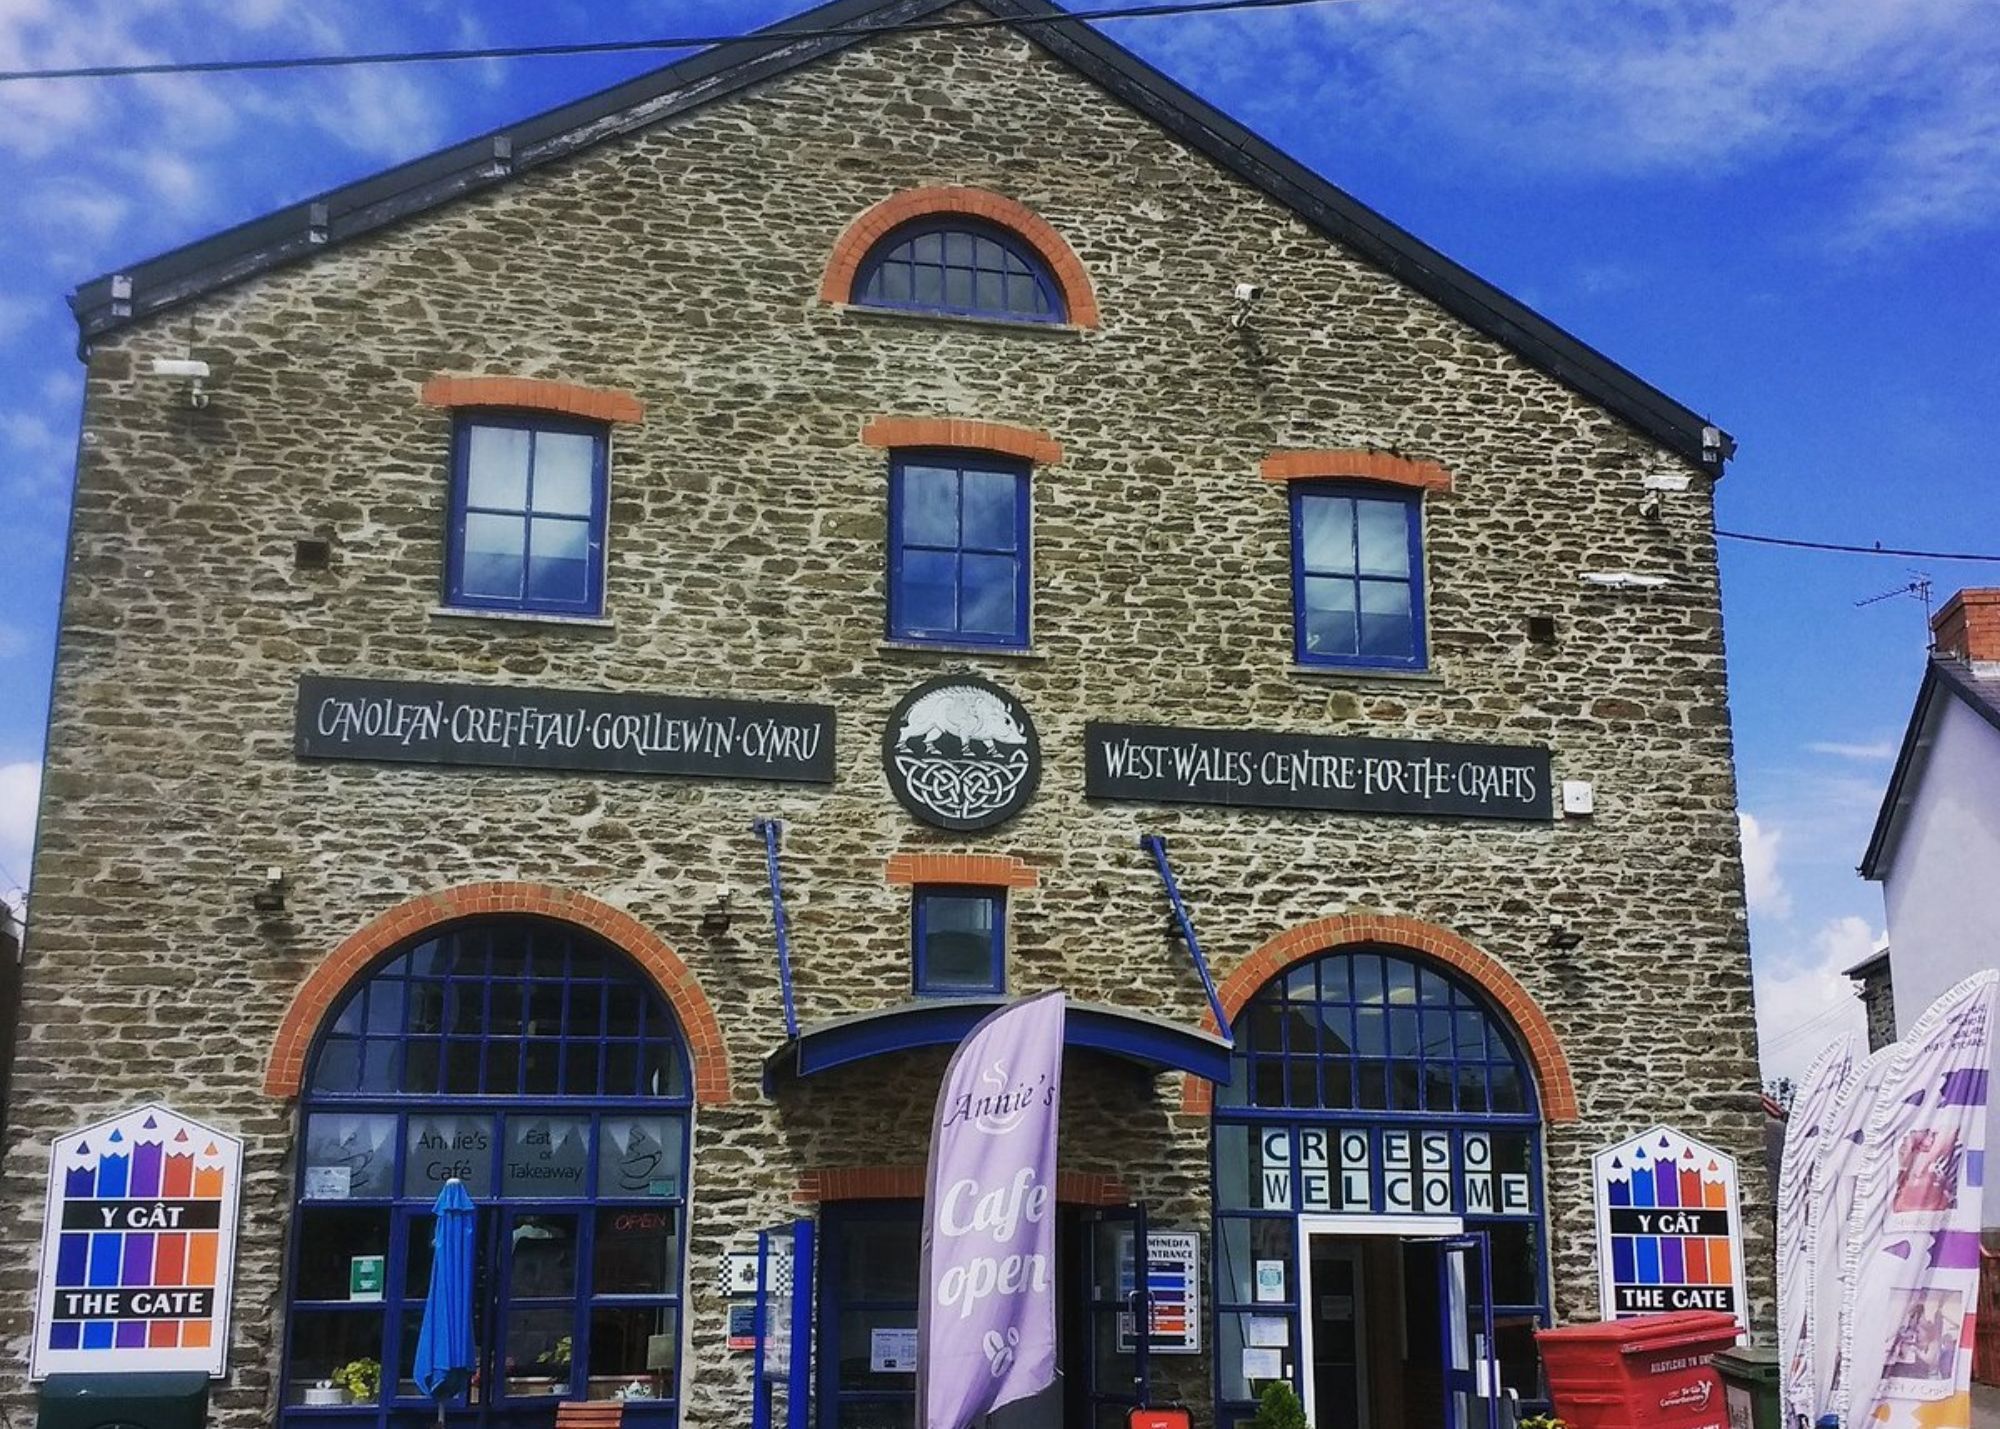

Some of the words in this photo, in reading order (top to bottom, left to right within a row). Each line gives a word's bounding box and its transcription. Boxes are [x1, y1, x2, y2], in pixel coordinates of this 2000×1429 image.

[318, 698, 443, 745] CANOLFAN
[451, 704, 586, 749] CREFFTAU
[592, 712, 737, 756] GORLLEWIN
[742, 719, 821, 762] CYMRU
[1102, 738, 1169, 779] WEST
[1171, 743, 1251, 786] WALES
[1260, 749, 1356, 791] CENTRE
[1364, 757, 1408, 794] FOR
[1408, 757, 1451, 799] THE
[1457, 761, 1536, 802] CRAFTS
[943, 1074, 1056, 1128] Annie's
[526, 1129, 552, 1145] Eat
[1264, 1133, 1489, 1165] CROESO
[426, 1160, 473, 1181] Café
[507, 1163, 584, 1184] Takeaway
[1265, 1174, 1527, 1207] WELCOME
[101, 1207, 119, 1228] Y
[127, 1202, 184, 1228] GÂT
[939, 1167, 1047, 1242] Cafe
[1638, 1215, 1652, 1232] Y
[1658, 1211, 1701, 1233] GÂT
[1146, 1250, 1193, 1259] NTRANCE
[938, 1254, 1047, 1318] open
[1622, 1289, 1664, 1307] THE
[1672, 1290, 1727, 1308] GATE
[65, 1294, 120, 1315] THE
[131, 1293, 203, 1314] GATE
